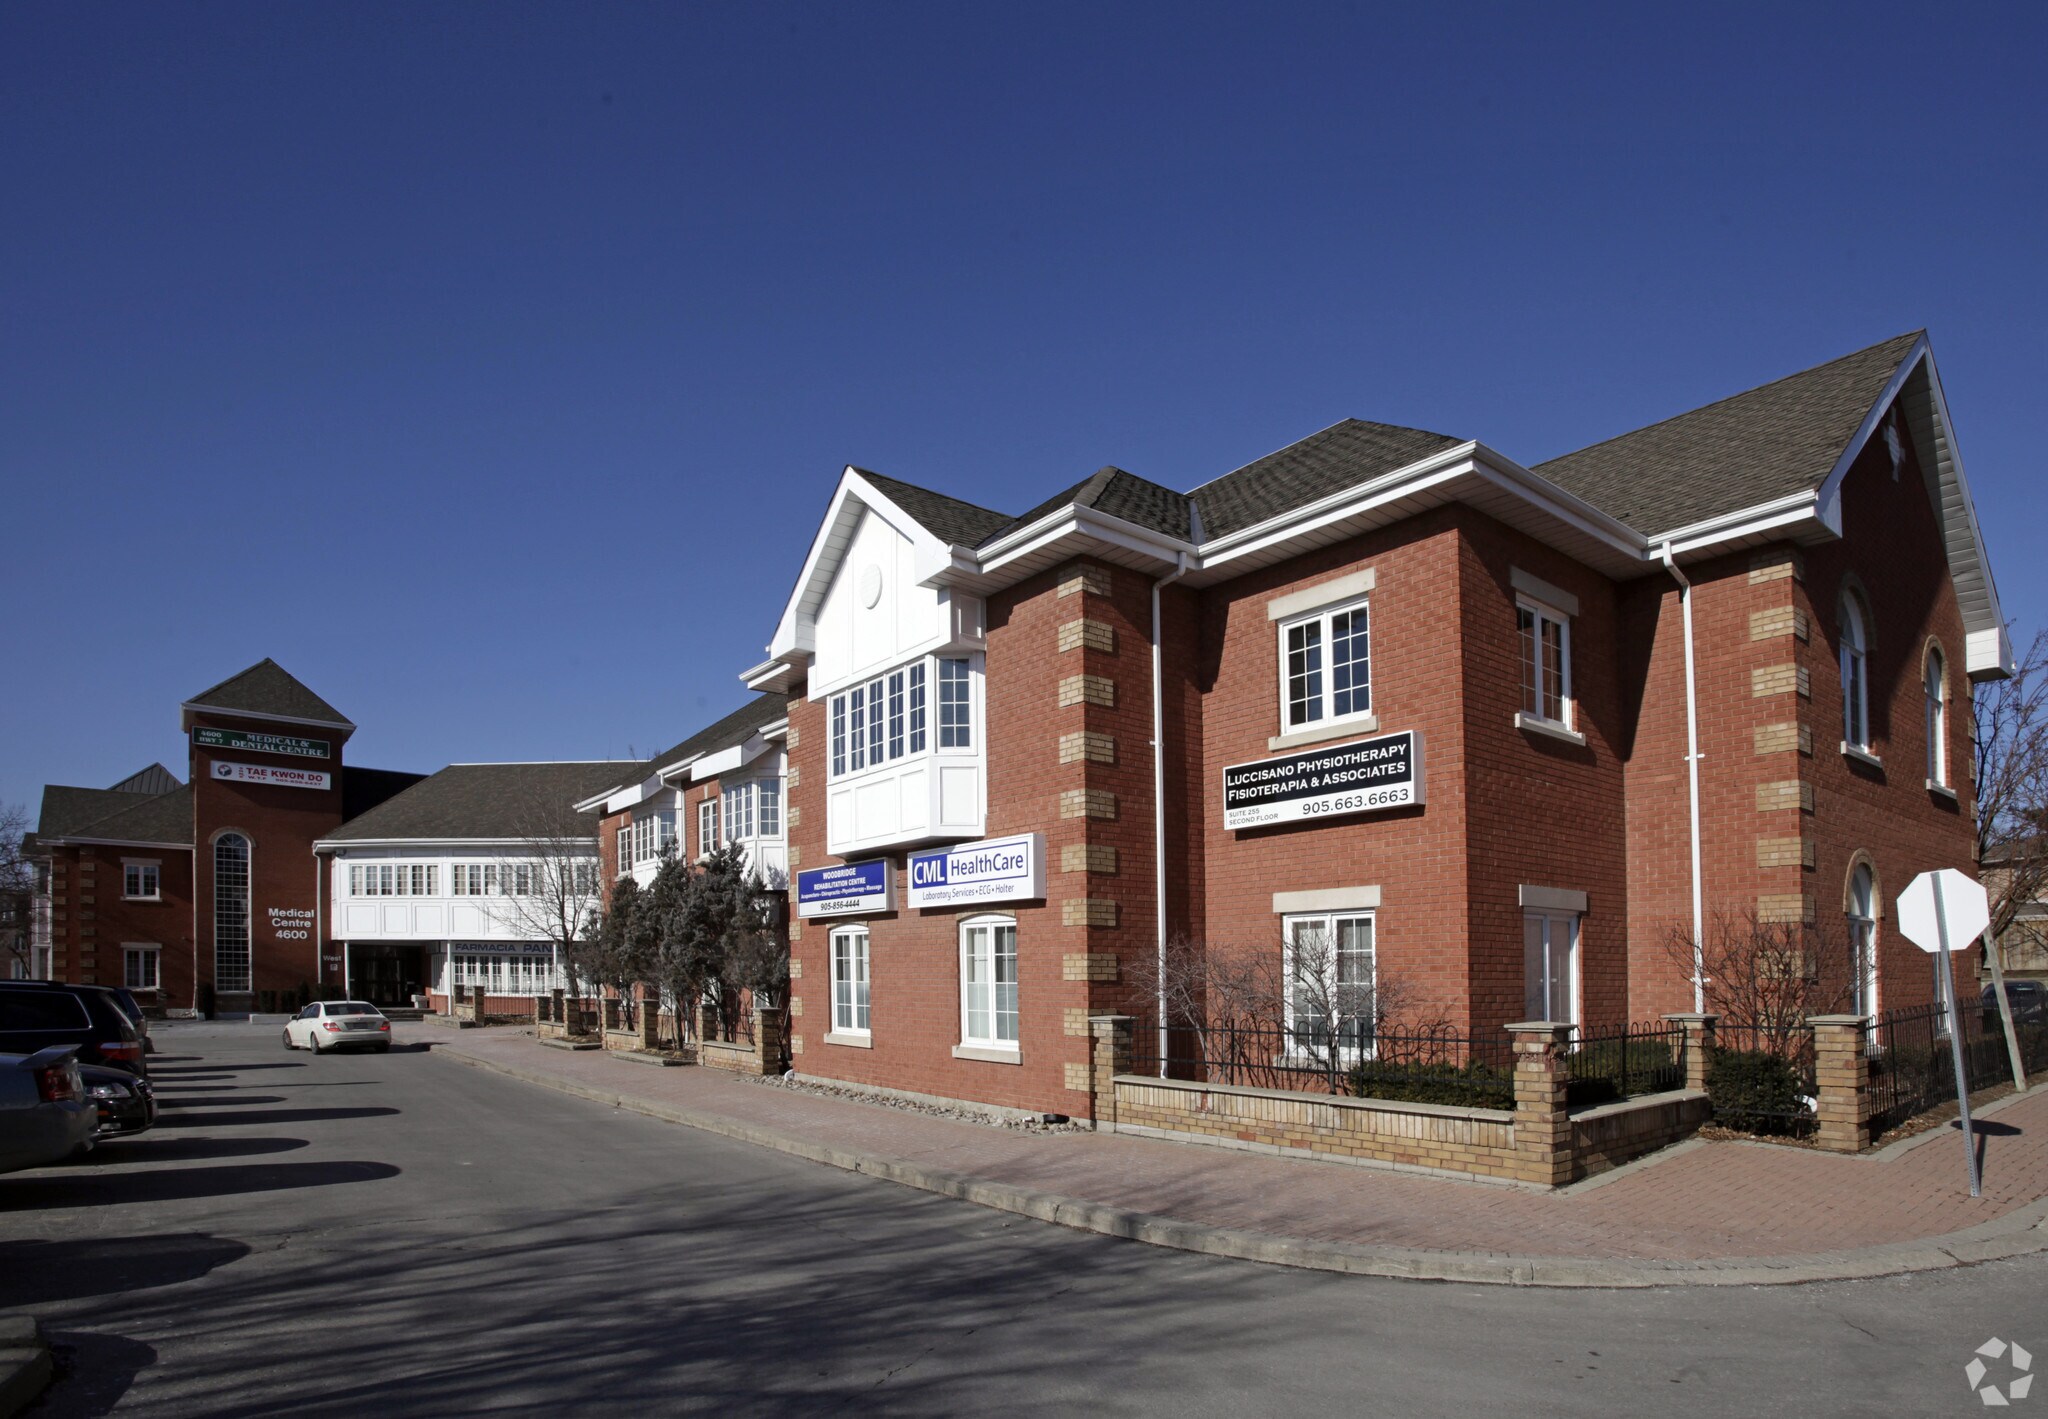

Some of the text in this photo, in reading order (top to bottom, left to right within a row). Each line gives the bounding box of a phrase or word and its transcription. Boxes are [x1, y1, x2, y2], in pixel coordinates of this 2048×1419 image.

[247, 734, 299, 747] MEDICAL
[231, 740, 324, 757] DENTAL CENTRE
[1227, 743, 1407, 786] LUCCISANO PHYSIOTHERAPY
[246, 767, 268, 776] TAE
[271, 770, 304, 780] KWON
[308, 774, 323, 782] DO
[1228, 761, 1406, 801] FISIOTERAPIA & ASSOCIATES
[1302, 788, 1409, 815] 905.663.6663
[1228, 810, 1246, 818] SUITE
[1229, 813, 1279, 825] SECOND FLOOR
[822, 867, 857, 880] WOODBRIDGE
[913, 853, 1024, 884] CML HealthCare
[813, 877, 866, 891] REHABILITATION CENTRE
[922, 884, 1014, 900] Laboratory Services ECG Holter
[820, 899, 860, 911] 905-856-4444
[268, 908, 315, 918] Medical
[272, 918, 312, 928] Centre
[275, 930, 308, 939] 4600
[455, 943, 516, 951] FARMACIA
